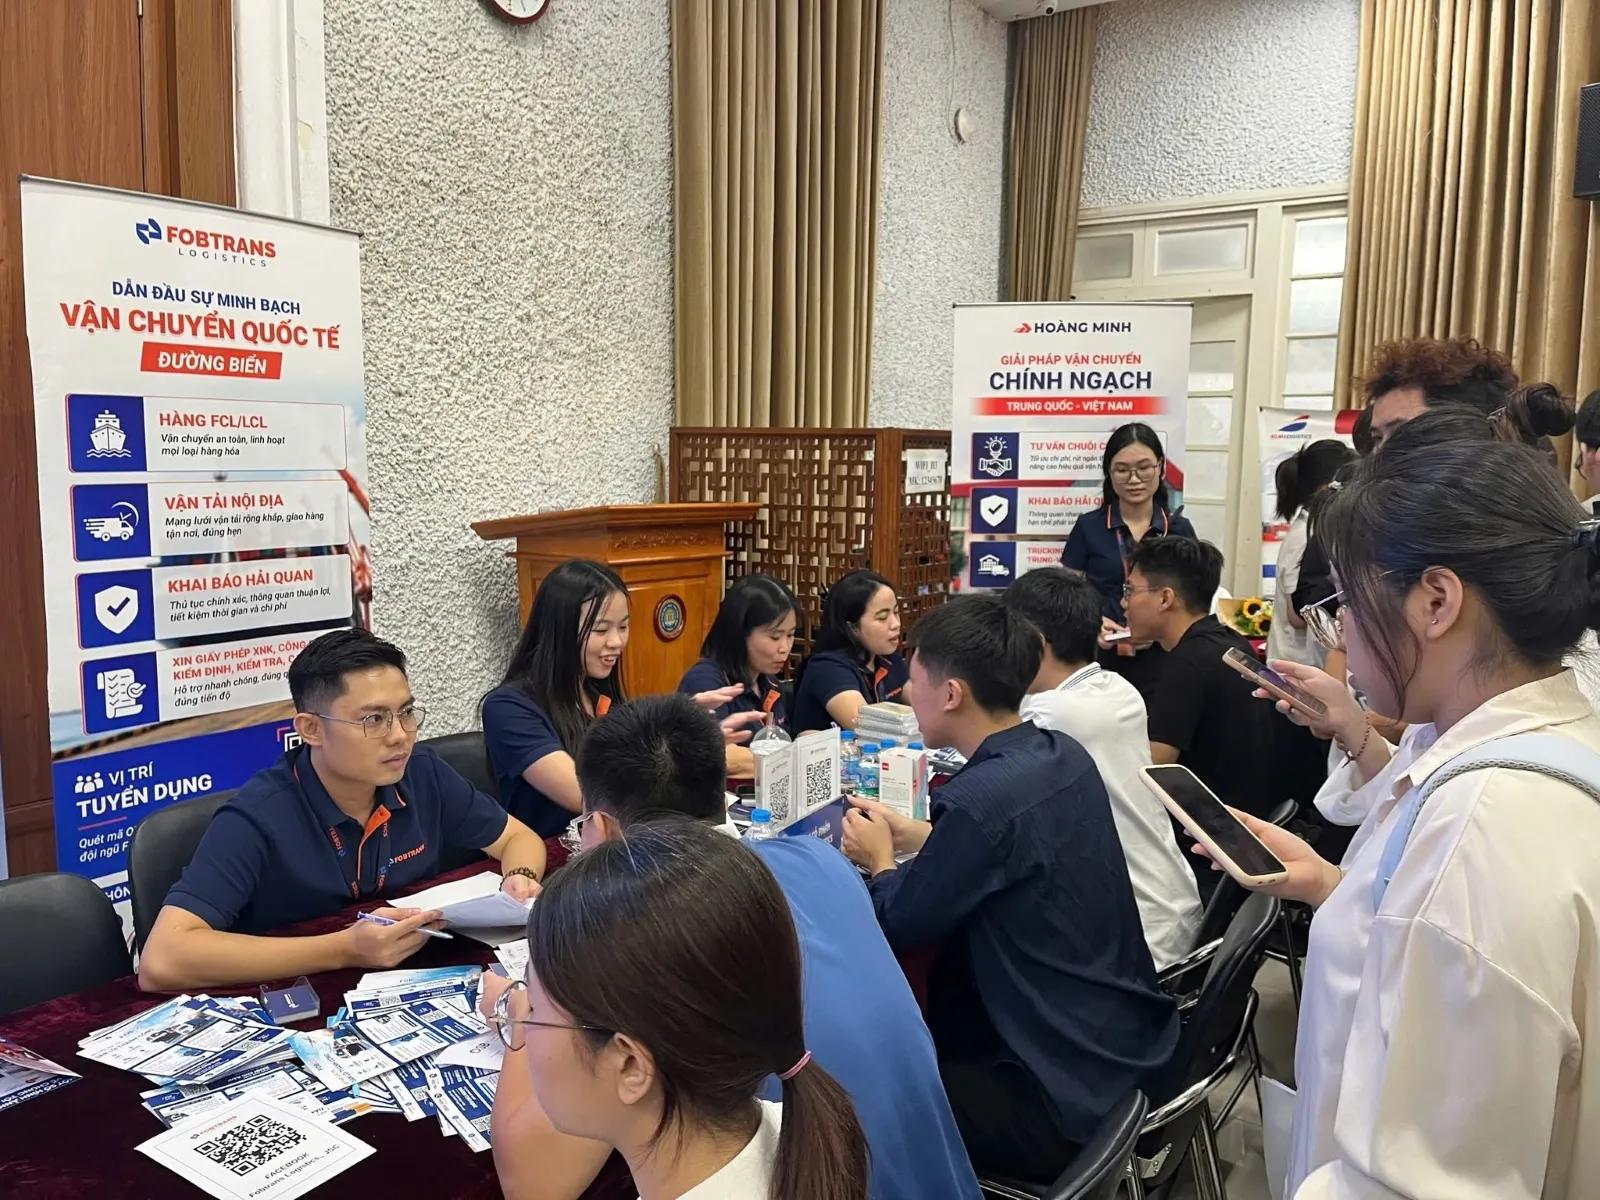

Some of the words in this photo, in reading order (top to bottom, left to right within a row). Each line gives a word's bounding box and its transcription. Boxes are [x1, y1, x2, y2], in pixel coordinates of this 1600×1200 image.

[166, 226, 276, 259] FOBTRANS
[178, 248, 267, 267] LOGISTICS
[112, 277, 148, 298] DẪN
[152, 283, 186, 302] ĐẦU
[190, 290, 214, 308] SỰ
[217, 293, 256, 310] MINH
[260, 299, 301, 316] BẠCH
[60, 299, 121, 335] VẬN
[128, 310, 236, 340] CHUYỂN
[241, 318, 308, 348] QUỐC
[312, 323, 341, 350] TẾ
[1034, 320, 1088, 333] HOÀNG
[1093, 322, 1132, 333] MINH
[157, 350, 225, 373] ĐƯỜNG
[229, 353, 267, 375] BIỂN
[1001, 352, 1025, 365] GIẢI
[1028, 352, 1061, 365] PHÁP
[1065, 353, 1090, 367] VẬN
[989, 367, 1063, 390] CHÍNH
[1070, 371, 1152, 394] NGẠCH
[1007, 401, 1042, 411] TRUNG
[1044, 399, 1073, 411] QUỐC
[1082, 400, 1105, 412] VIỆT
[1107, 401, 1133, 411] NAM
[159, 410, 206, 427] HÀNG
[210, 414, 268, 429] FCL/LCL
[161, 434, 178, 444] Vận
[228, 435, 248, 445] toàn,
[250, 435, 265, 444] linh
[266, 436, 285, 445] hoạt
[1030, 442, 1044, 451] TƯ
[161, 446, 179, 457] mọi
[182, 446, 198, 457] loại
[200, 446, 223, 457] hàng
[224, 446, 240, 456] hóa
[164, 493, 199, 513] VẬN
[202, 492, 227, 509] TẢI
[231, 492, 256, 510] NỘI
[259, 494, 284, 510] ĐỊA
[1027, 497, 1051, 506] KHAI
[1053, 496, 1073, 506] BÁO
[165, 517, 191, 527] Mạng
[194, 515, 212, 525] lưới
[213, 515, 229, 526] vận
[231, 513, 241, 523] tải
[243, 513, 261, 525] rộng
[286, 511, 304, 522] giao
[305, 511, 325, 522] hàng
[166, 529, 181, 540] tận
[183, 528, 200, 539] nơi,
[202, 527, 225, 538] đúng
[227, 526, 242, 537] hẹn
[168, 577, 207, 594] KHAI
[211, 573, 242, 590] BÁO
[246, 569, 270, 587] HẢI
[273, 569, 313, 584] QUAN
[170, 599, 188, 610] Thủ
[189, 599, 205, 610] tục
[206, 595, 231, 607] chính
[232, 594, 249, 605] xác,
[250, 591, 273, 603] thông
[274, 590, 294, 602] quan
[296, 588, 319, 599] thuận
[320, 586, 331, 596] lợi,
[170, 612, 186, 622] tiết
[187, 610, 210, 621] kiệm
[212, 608, 229, 618] thời
[230, 607, 248, 618] gian
[250, 606, 259, 614] và
[260, 603, 273, 613] chi
[274, 602, 288, 614] phí
[172, 655, 192, 667] XIN
[195, 651, 221, 665] GIẤY
[224, 647, 250, 661] PHÉP
[253, 644, 276, 656] XNK,
[278, 640, 306, 652] CÔNG
[204, 664, 234, 678] ĐỊNH,
[262, 656, 286, 669] TRA,
[189, 683, 203, 694] trợ
[204, 679, 231, 692] nhanh
[233, 674, 260, 688] chóng,
[261, 672, 281, 684] đúng
[174, 696, 198, 708] đúng
[200, 693, 217, 705] tiến
[219, 690, 231, 702] độ
[108, 770, 125, 787] VỊ
[127, 761, 154, 781] TRÍ
[76, 784, 149, 818] TUYỂN
[154, 774, 212, 801] DỤNG
[79, 833, 105, 849] Quét
[107, 829, 124, 841] mã
[79, 848, 97, 863] đội
[100, 844, 120, 859] ngũ
[248, 1176, 285, 1198] Fobtrans
[324, 1144, 340, 1155] JSC
[264, 1152, 311, 1180] FACEBOOK
